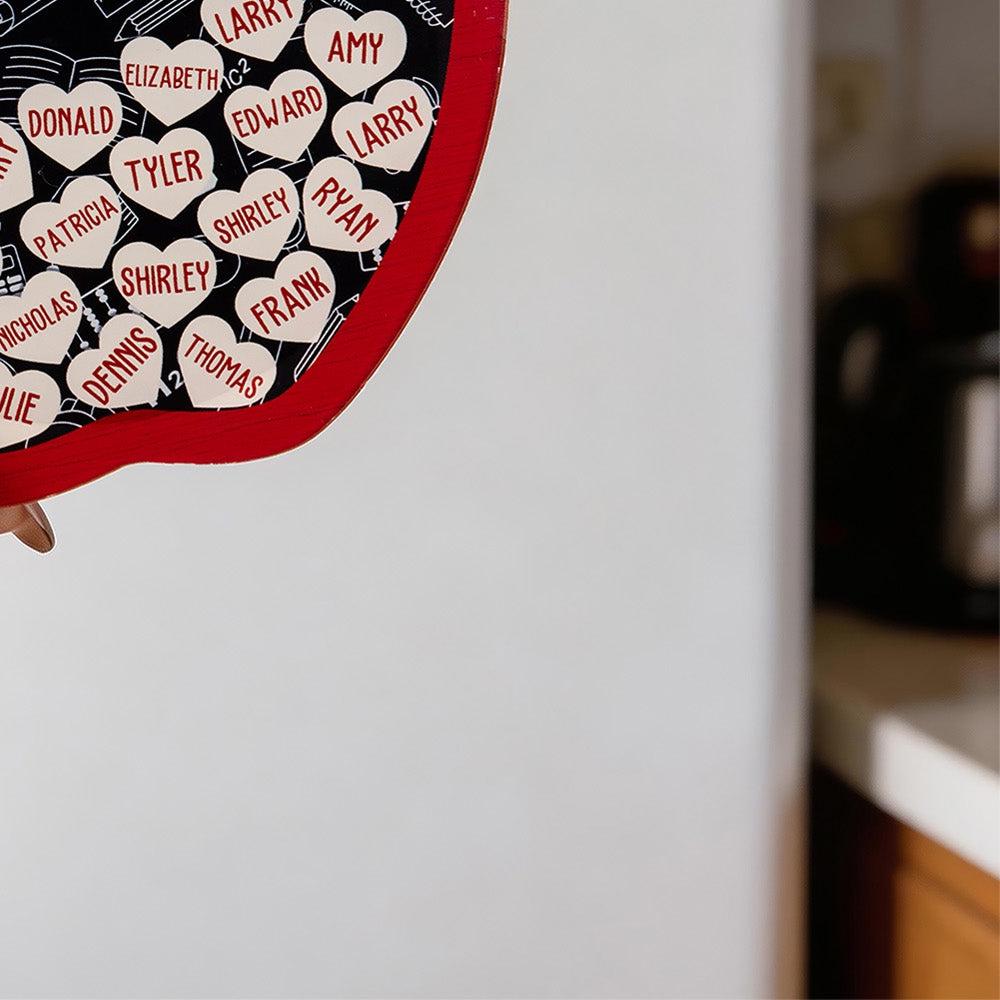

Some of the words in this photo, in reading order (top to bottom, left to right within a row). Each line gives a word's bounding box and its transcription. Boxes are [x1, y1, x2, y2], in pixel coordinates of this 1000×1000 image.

[125, 63, 219, 90] ELIZABETH
[327, 30, 384, 65] AMY
[27, 105, 114, 138] DONALD
[231, 85, 323, 138] EDWARD
[346, 95, 424, 159] LARRY
[124, 149, 203, 191] TYLER
[33, 195, 119, 259] PATRICIA
[213, 187, 291, 245] SHIRLEY
[311, 176, 380, 243] RYAN
[120, 261, 210, 297] SHIRLEY
[250, 266, 331, 335] FRANK
[81, 327, 158, 406] DENNIS
[184, 333, 264, 399] THOMAS
